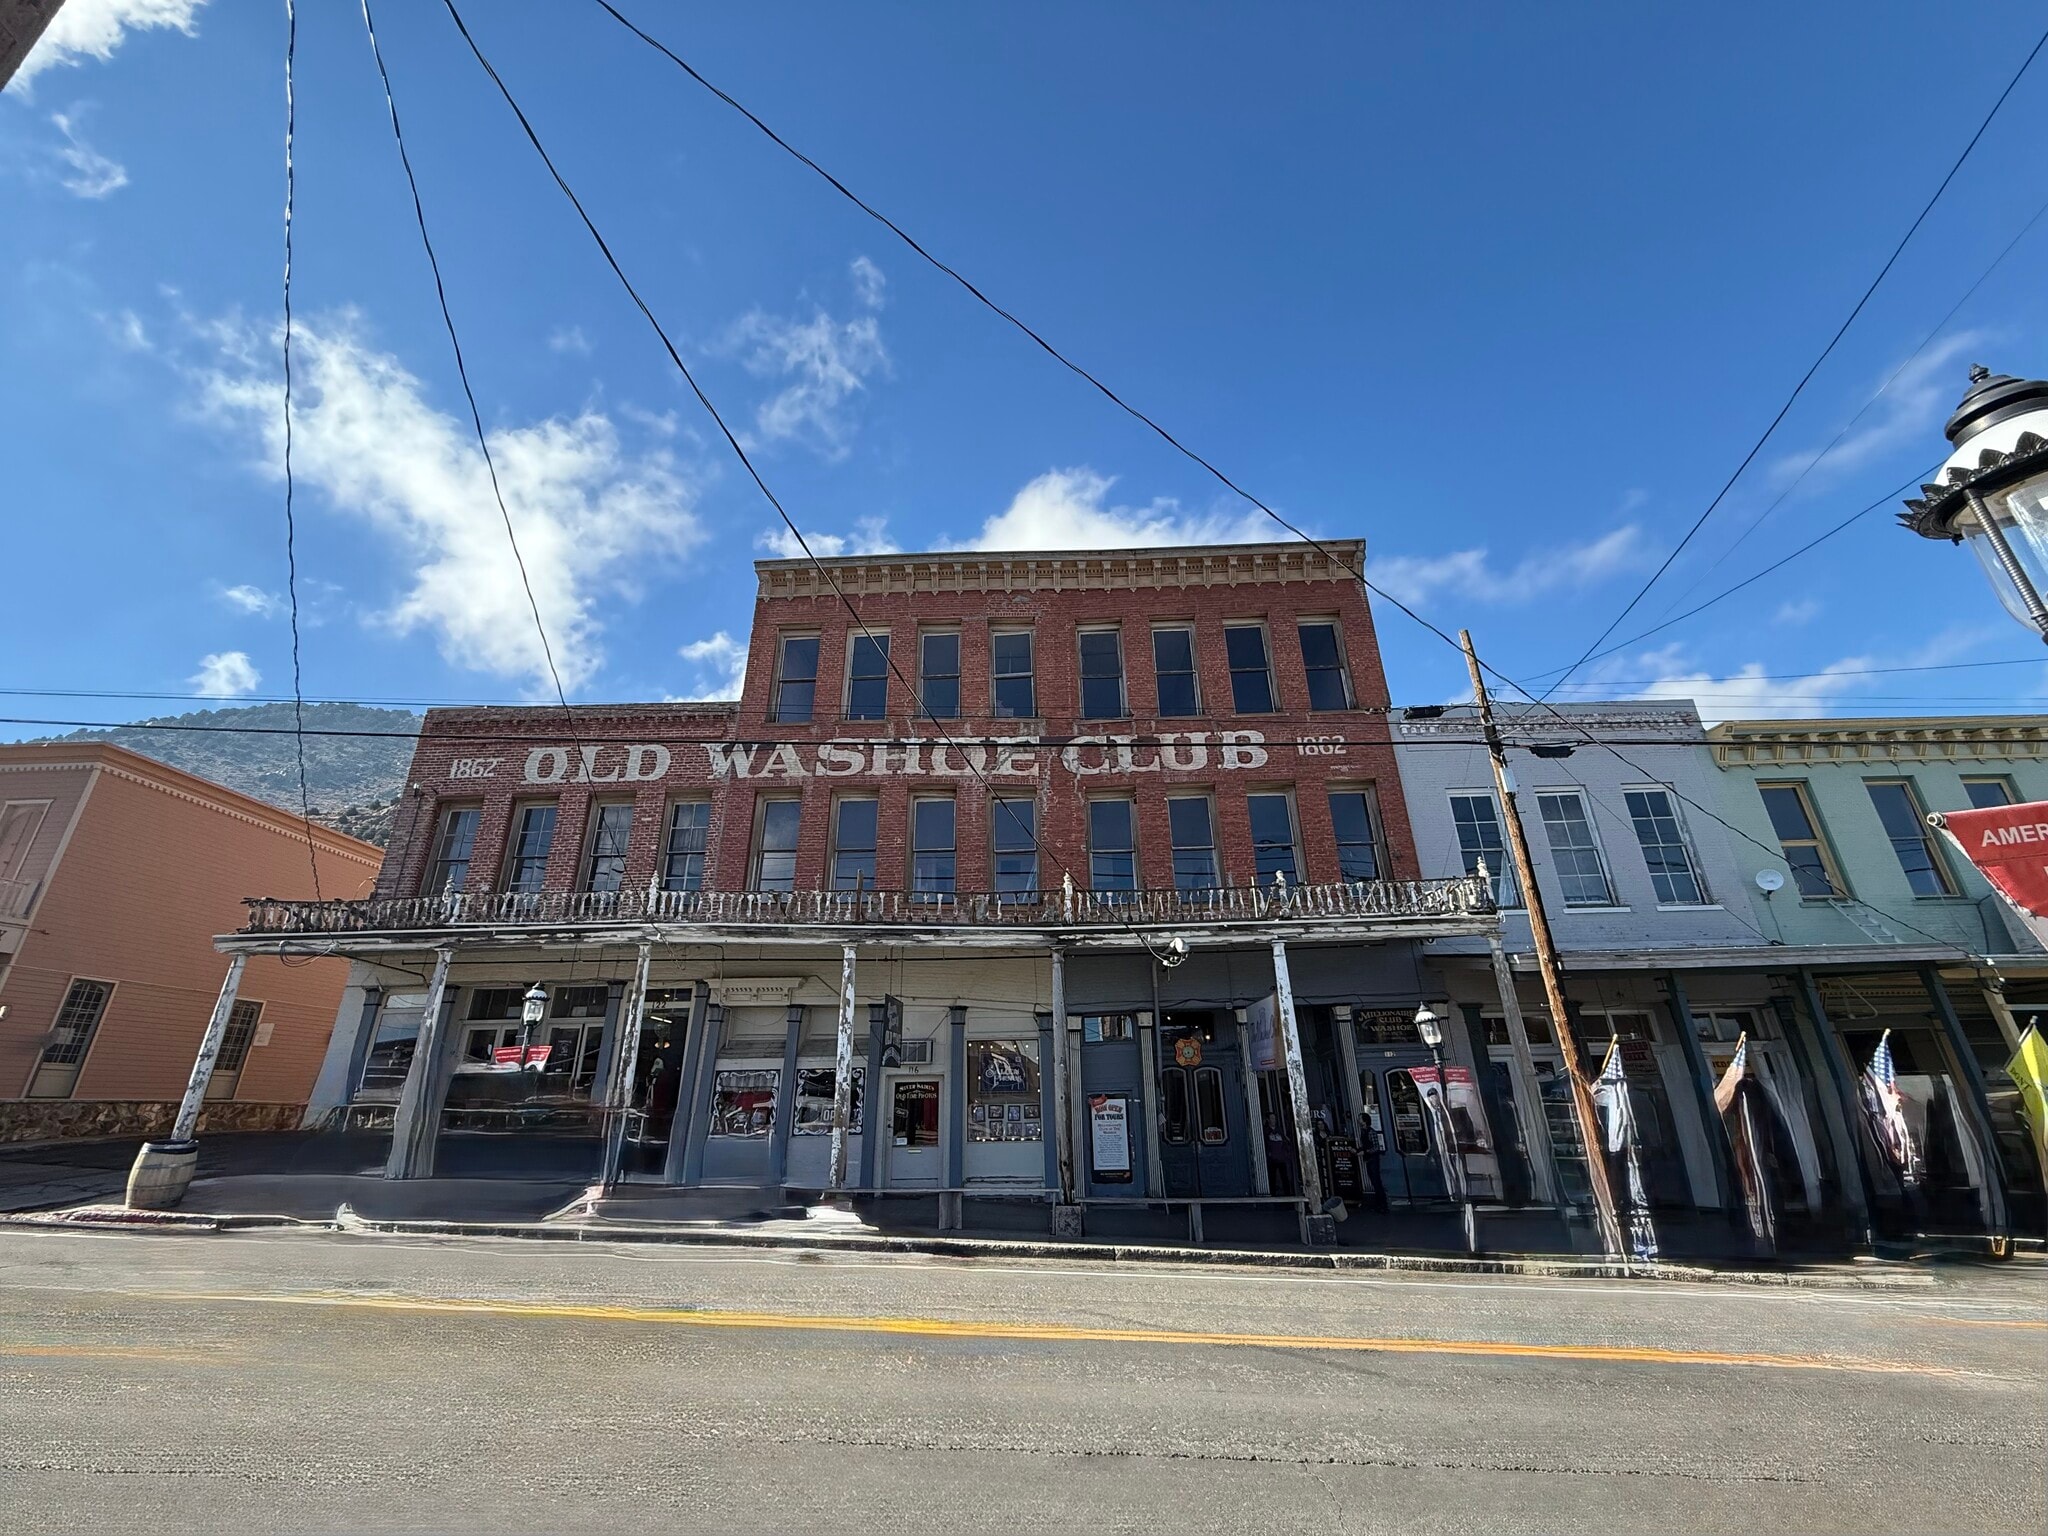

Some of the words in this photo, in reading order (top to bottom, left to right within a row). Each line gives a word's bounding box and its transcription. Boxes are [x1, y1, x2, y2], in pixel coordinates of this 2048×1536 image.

[449, 758, 502, 779] 1862
[521, 743, 672, 786] OLD
[700, 735, 1040, 781] WASHOE
[1060, 729, 1269, 774] CLUB
[1296, 735, 1348, 755] 1862
